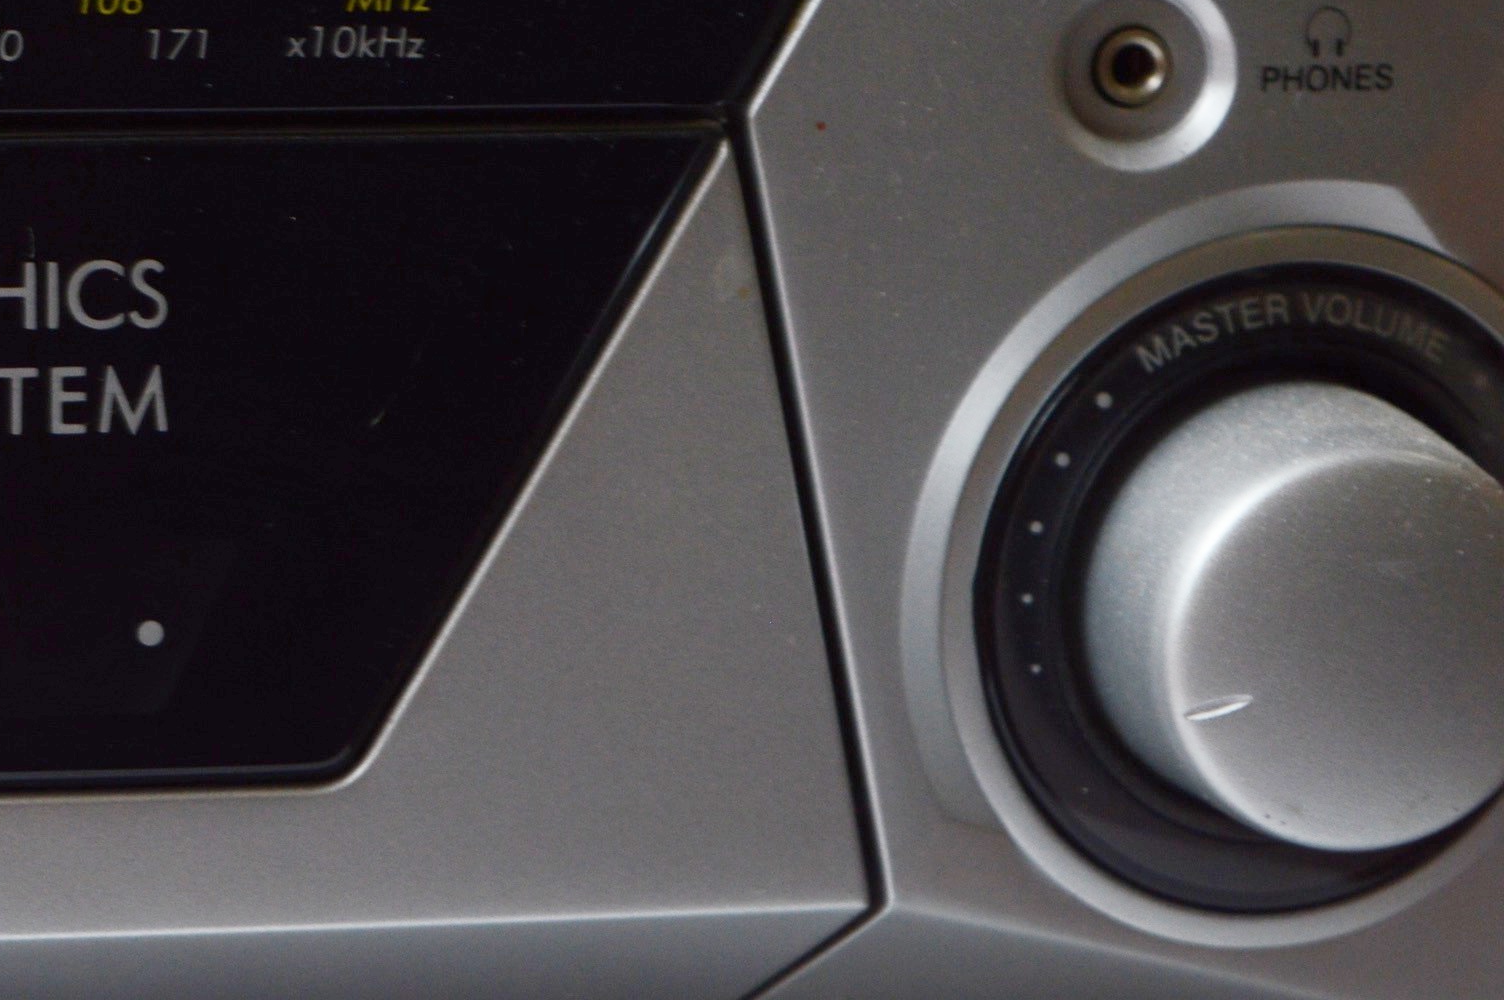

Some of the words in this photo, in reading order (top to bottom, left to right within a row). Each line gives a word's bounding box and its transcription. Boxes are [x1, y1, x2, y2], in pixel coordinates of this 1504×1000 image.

[148, 28, 209, 60] 171
[286, 25, 425, 59] x10kHz
[1261, 66, 1395, 94] PHONES
[1134, 293, 1290, 373] MASTER
[1302, 293, 1450, 364] VOLUME
